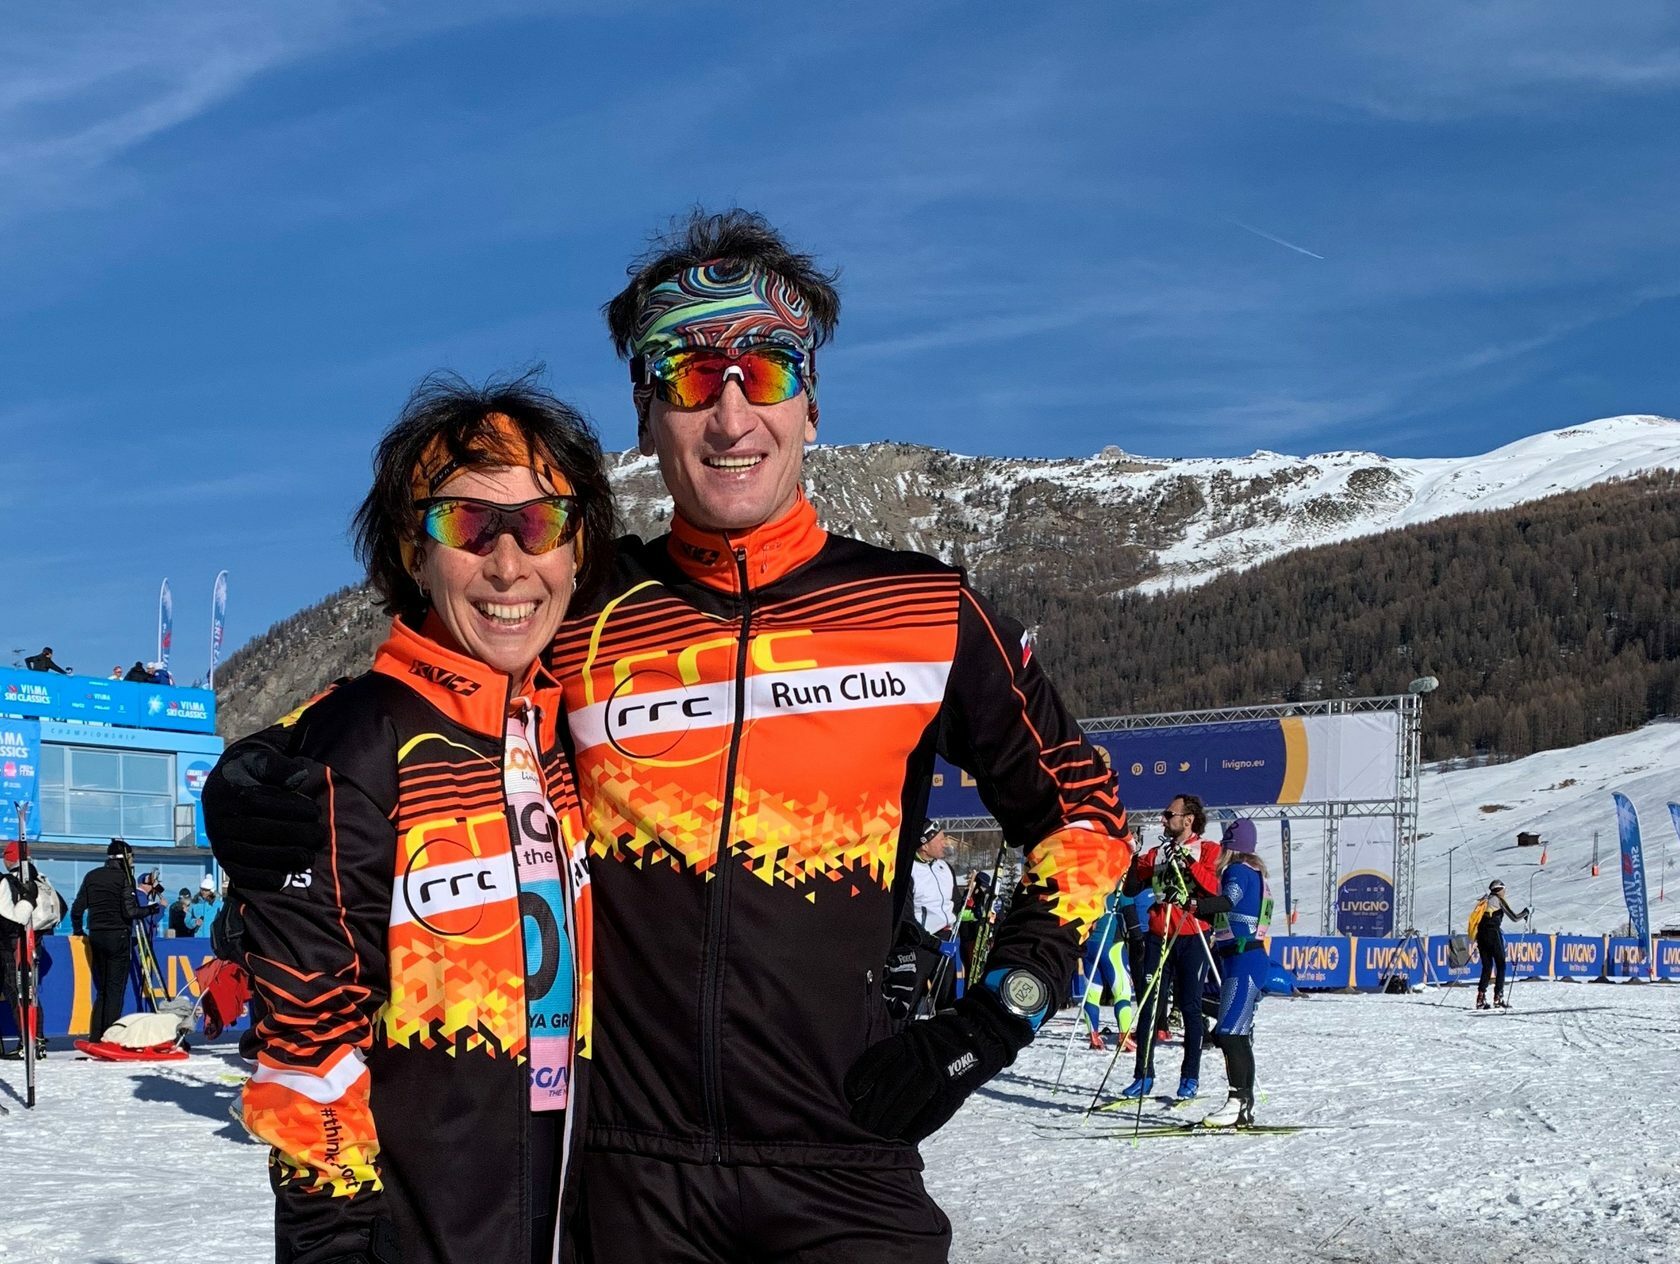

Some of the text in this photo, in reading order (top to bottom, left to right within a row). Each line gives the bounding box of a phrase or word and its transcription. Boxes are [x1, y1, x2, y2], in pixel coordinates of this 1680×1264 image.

[20, 684, 48, 696] VISMA
[771, 671, 907, 708] Run Club
[4, 692, 51, 705] SKI CLASSICS
[181, 700, 205, 711] VISMA
[177, 709, 208, 720] CLASSICS
[618, 697, 712, 727] rrc
[1222, 759, 1265, 771] livigno.eu
[524, 849, 553, 866] the
[420, 871, 497, 904] rrc
[1342, 901, 1389, 912] LIVIGNO
[1283, 946, 1339, 970] LIVIGNO
[1562, 943, 1597, 964] LIVIGNO
[948, 1052, 976, 1077] YOKO
